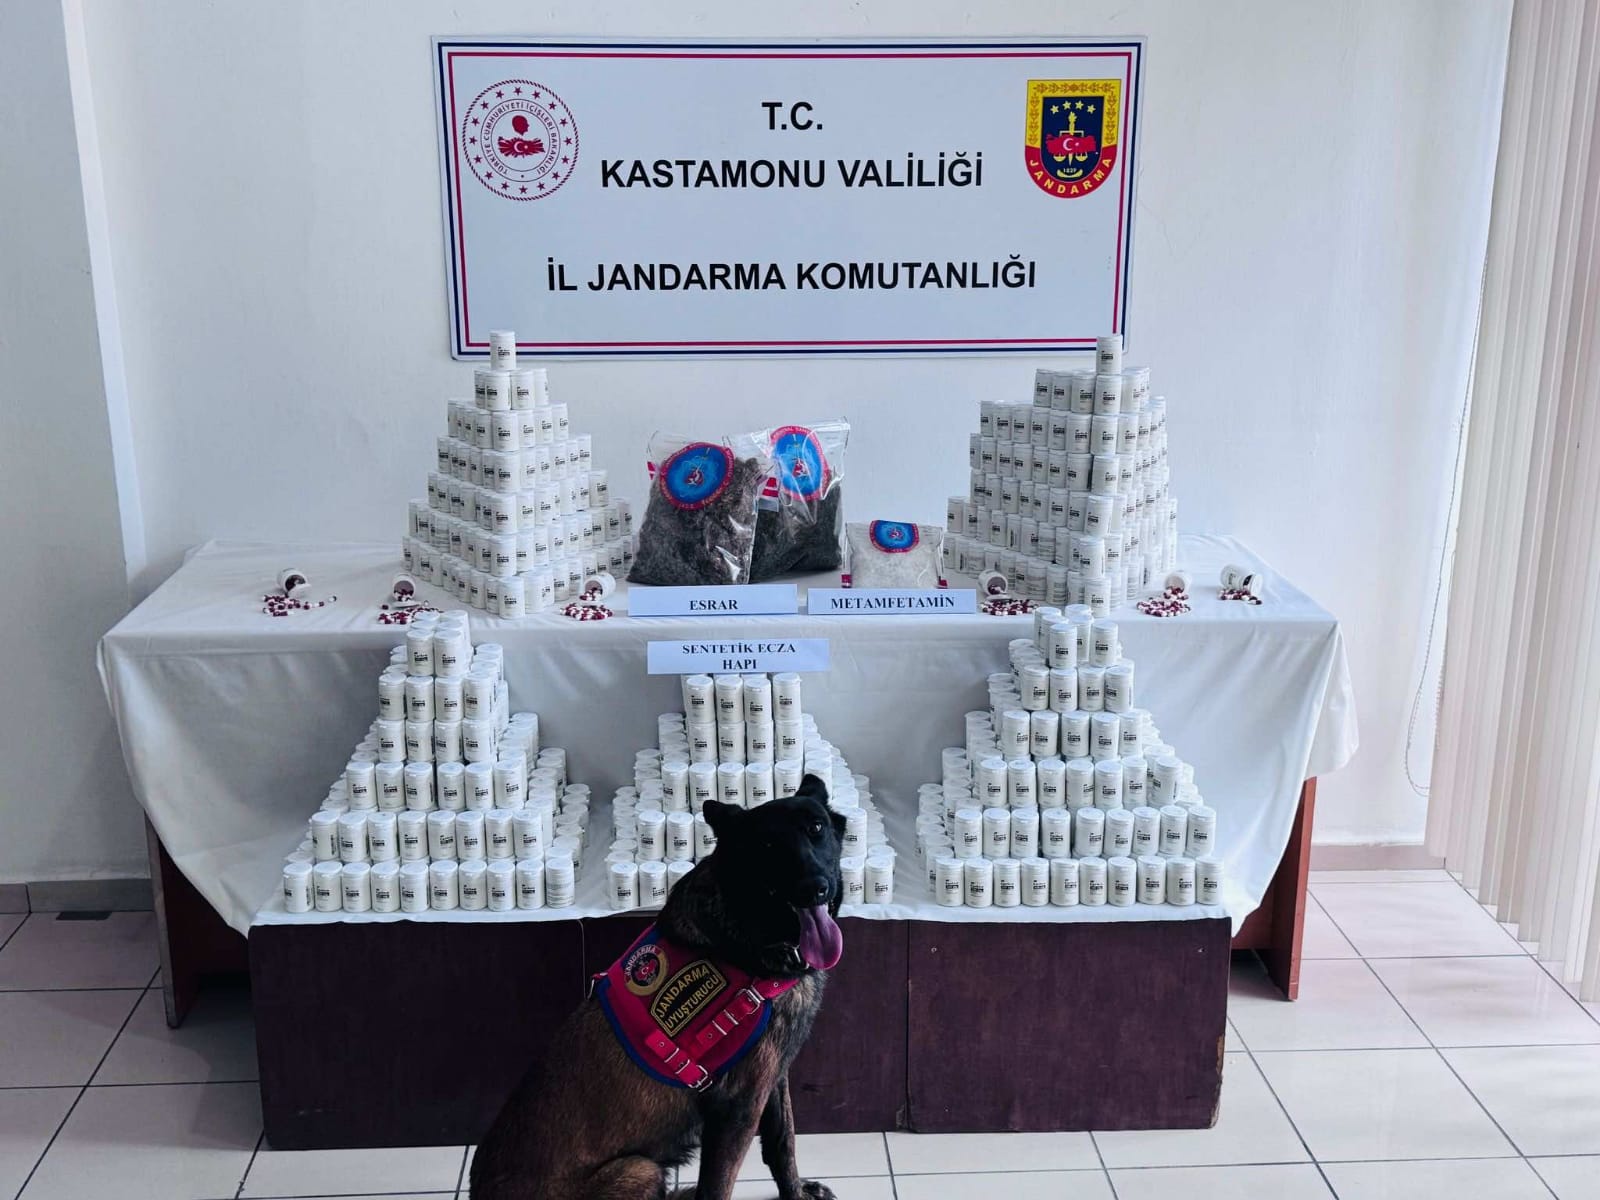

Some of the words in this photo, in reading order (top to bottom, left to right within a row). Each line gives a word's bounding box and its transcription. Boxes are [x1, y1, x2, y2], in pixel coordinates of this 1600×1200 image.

[484, 101, 524, 140] CUMHURİYETİ
[762, 102, 822, 130] T.C.
[602, 160, 824, 188] KASTAMONU
[838, 152, 982, 187] VALİLİĞİ
[1030, 158, 1112, 194] JANDARMA
[548, 257, 577, 290] İL
[588, 264, 786, 291] JANDARMA
[797, 254, 1035, 289] KOMUTANLIĞI
[690, 599, 738, 611] ESRAR
[831, 595, 955, 609] METAMFETAMİN
[682, 641, 753, 654] SENTETİK
[757, 643, 796, 653] ECZA
[722, 659, 757, 670] HAPI
[624, 945, 657, 976] JANDARMA
[656, 965, 710, 1018] JANDARMA
[665, 974, 719, 1029] UYUŞTURUCU
